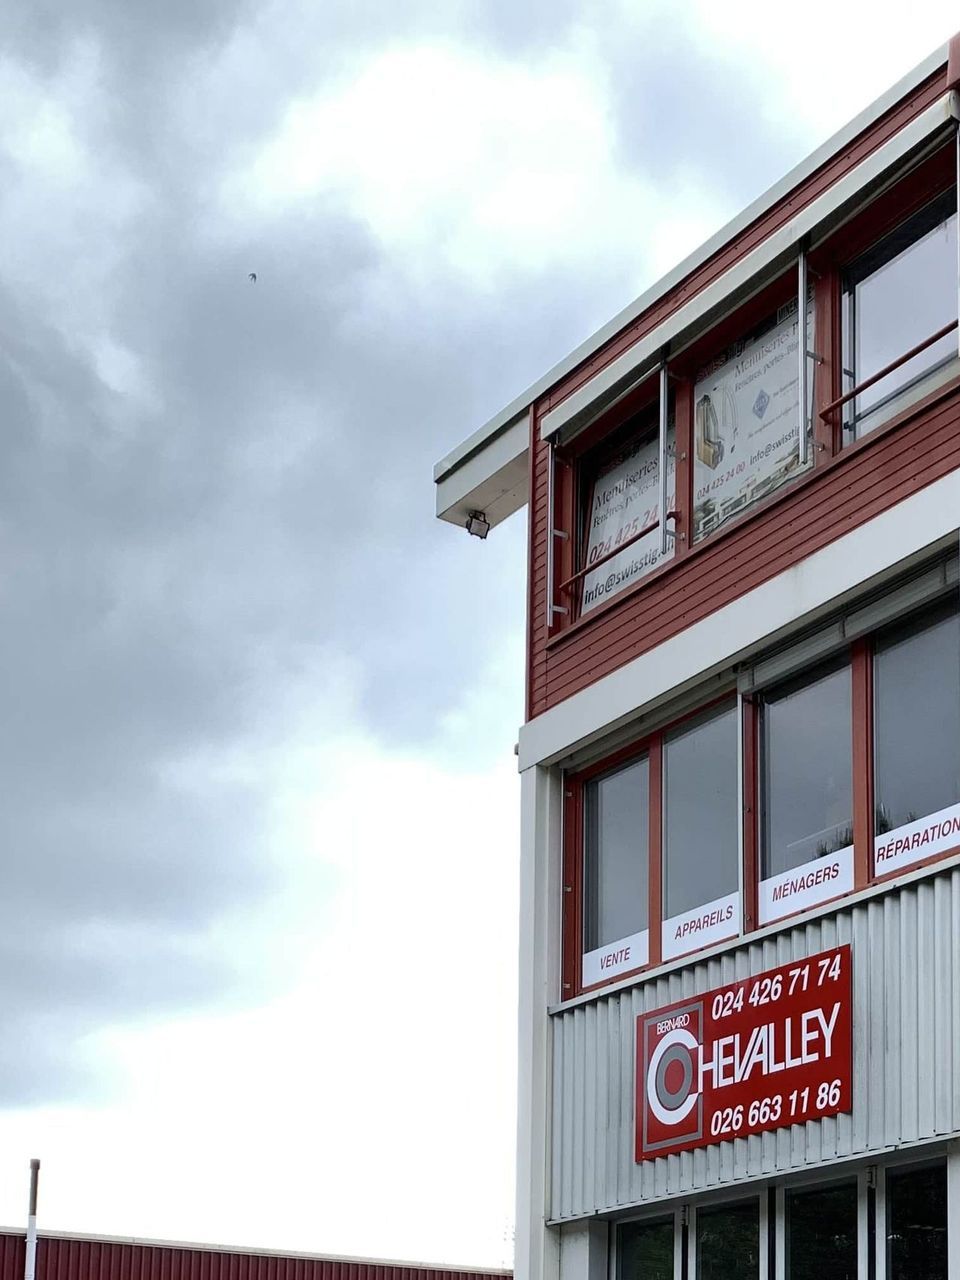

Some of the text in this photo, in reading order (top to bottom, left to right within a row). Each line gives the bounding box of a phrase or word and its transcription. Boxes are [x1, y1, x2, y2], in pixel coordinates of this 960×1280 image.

[594, 457, 659, 511] Menuiseries
[589, 535, 612, 565] 024
[615, 517, 640, 547] 425
[642, 503, 660, 531] 24
[772, 862, 840, 903] MÉNAGERS
[674, 904, 734, 940] APPAREILS
[600, 946, 631, 971] VENTE
[711, 954, 841, 1021] 024 426 71 74
[656, 1014, 690, 1036] BERNARD
[647, 1002, 841, 1126] CHEVALLEY
[711, 1079, 841, 1137] 026 663 11 86
